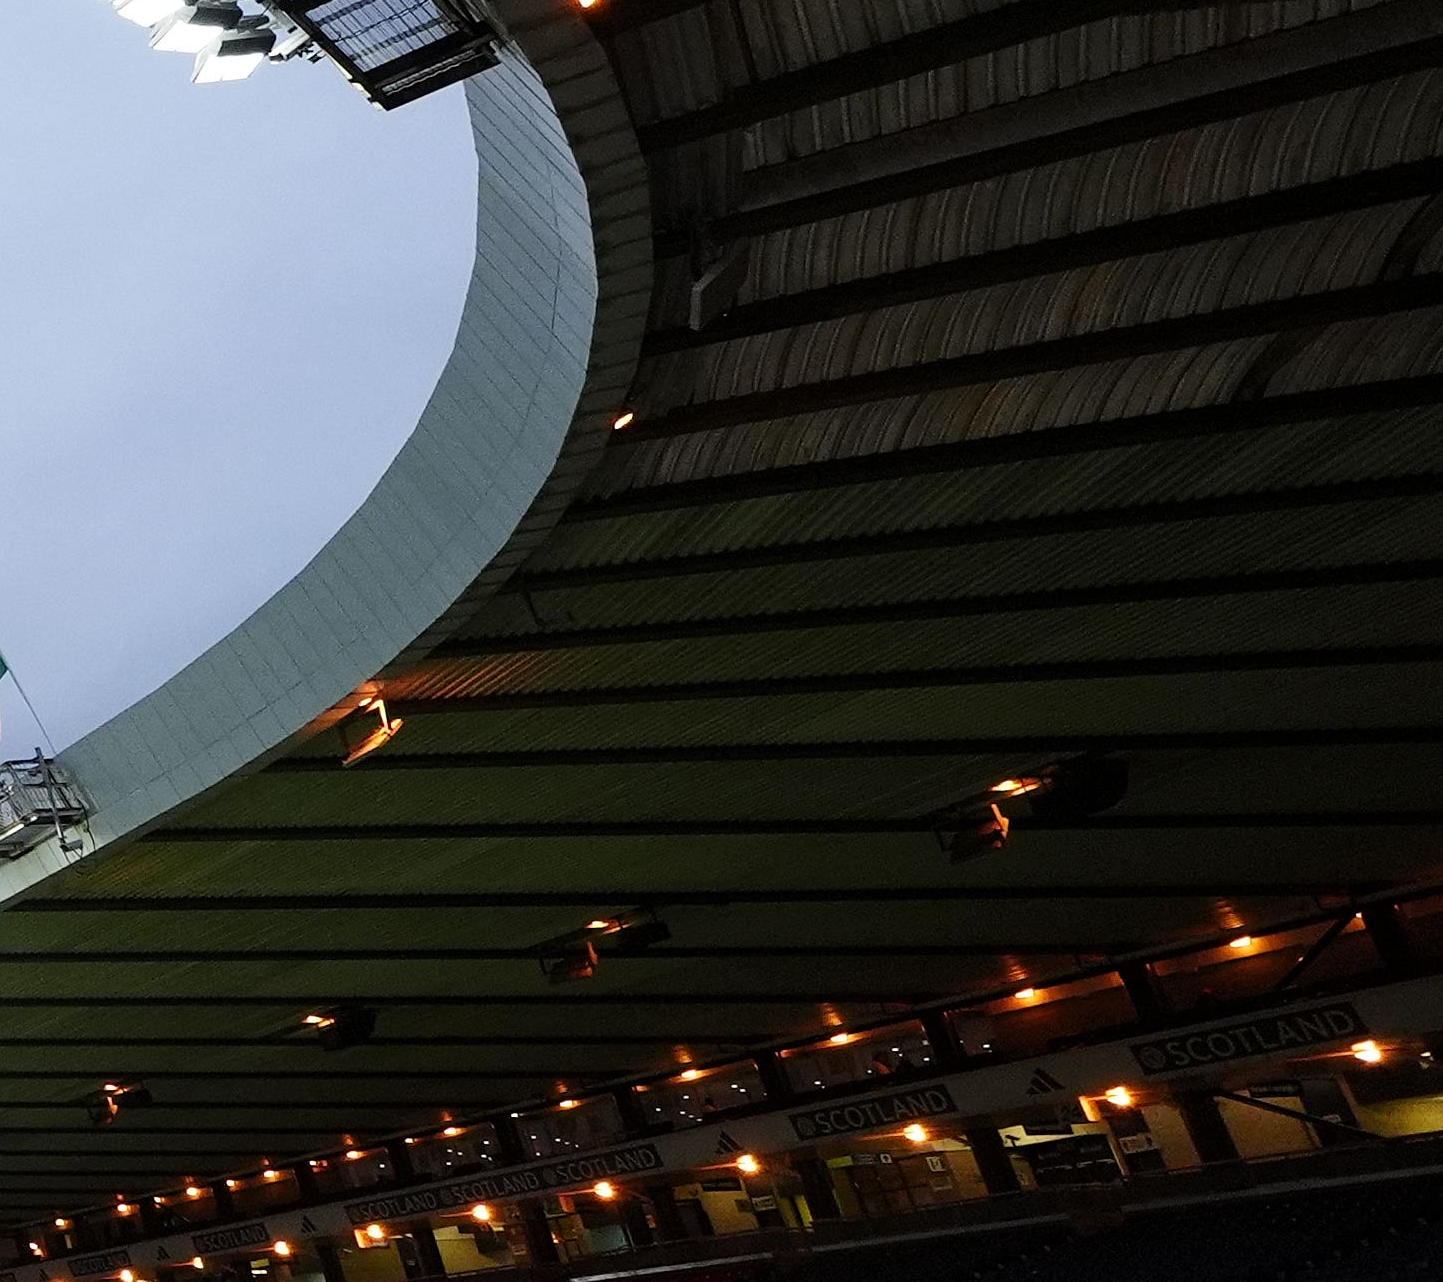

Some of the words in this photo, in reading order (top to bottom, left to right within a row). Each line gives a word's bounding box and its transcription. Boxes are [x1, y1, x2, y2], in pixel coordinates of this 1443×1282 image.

[1170, 1008, 1357, 1066] SCOTLAND
[816, 1090, 949, 1134] SCOTLAND
[556, 1148, 656, 1184] SCOTLAND
[451, 1171, 538, 1204] SCOTLAND
[359, 1192, 437, 1219] SCOTLAND
[203, 1225, 266, 1250] SCOTLAND
